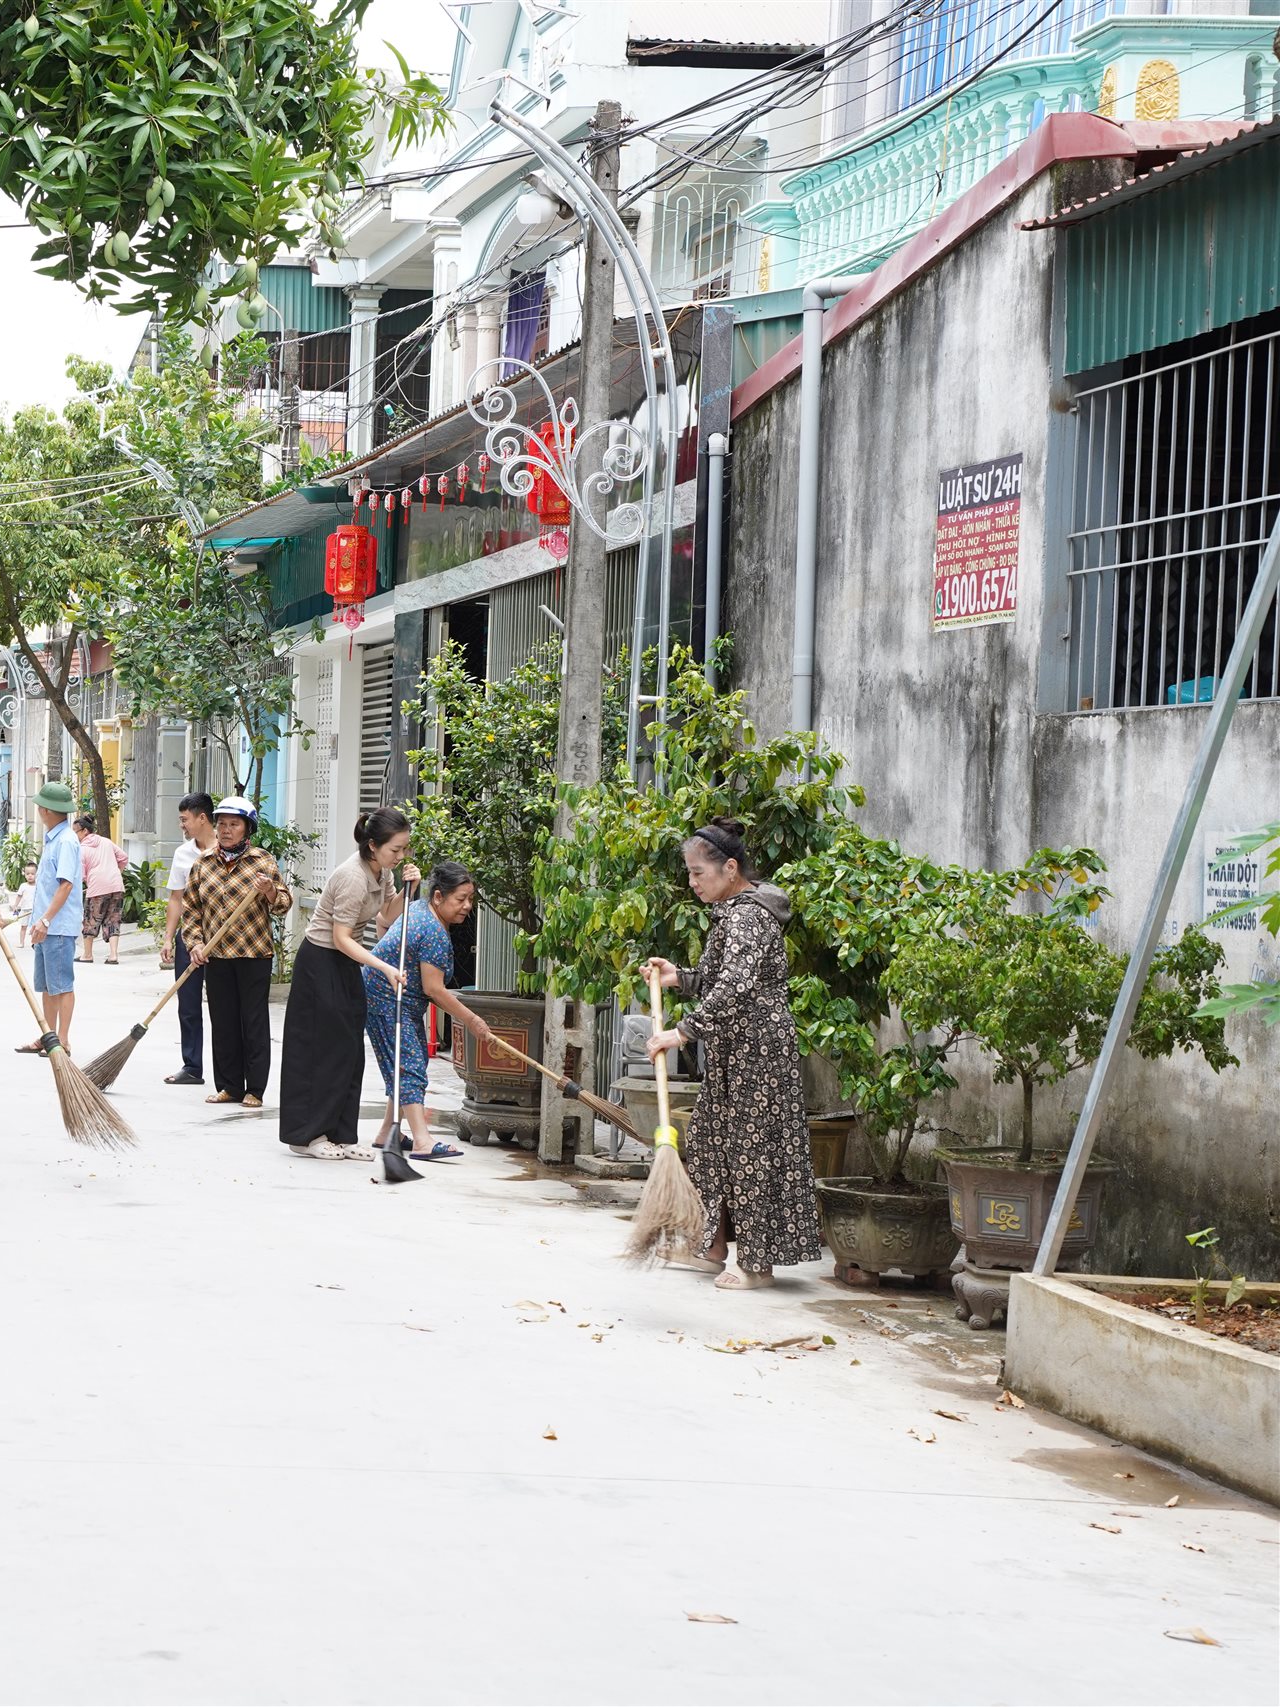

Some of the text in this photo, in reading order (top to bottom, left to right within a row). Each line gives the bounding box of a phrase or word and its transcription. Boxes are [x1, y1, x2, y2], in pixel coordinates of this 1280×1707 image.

[939, 463, 1022, 512] LUẬT SƯ 24H
[974, 507, 994, 519] PHÁP
[995, 502, 1015, 515] LUẬT
[937, 542, 951, 553] THU
[986, 531, 1006, 543] HÌNH
[942, 566, 1017, 617] 1900.6574
[1237, 858, 1257, 888] DỘT
